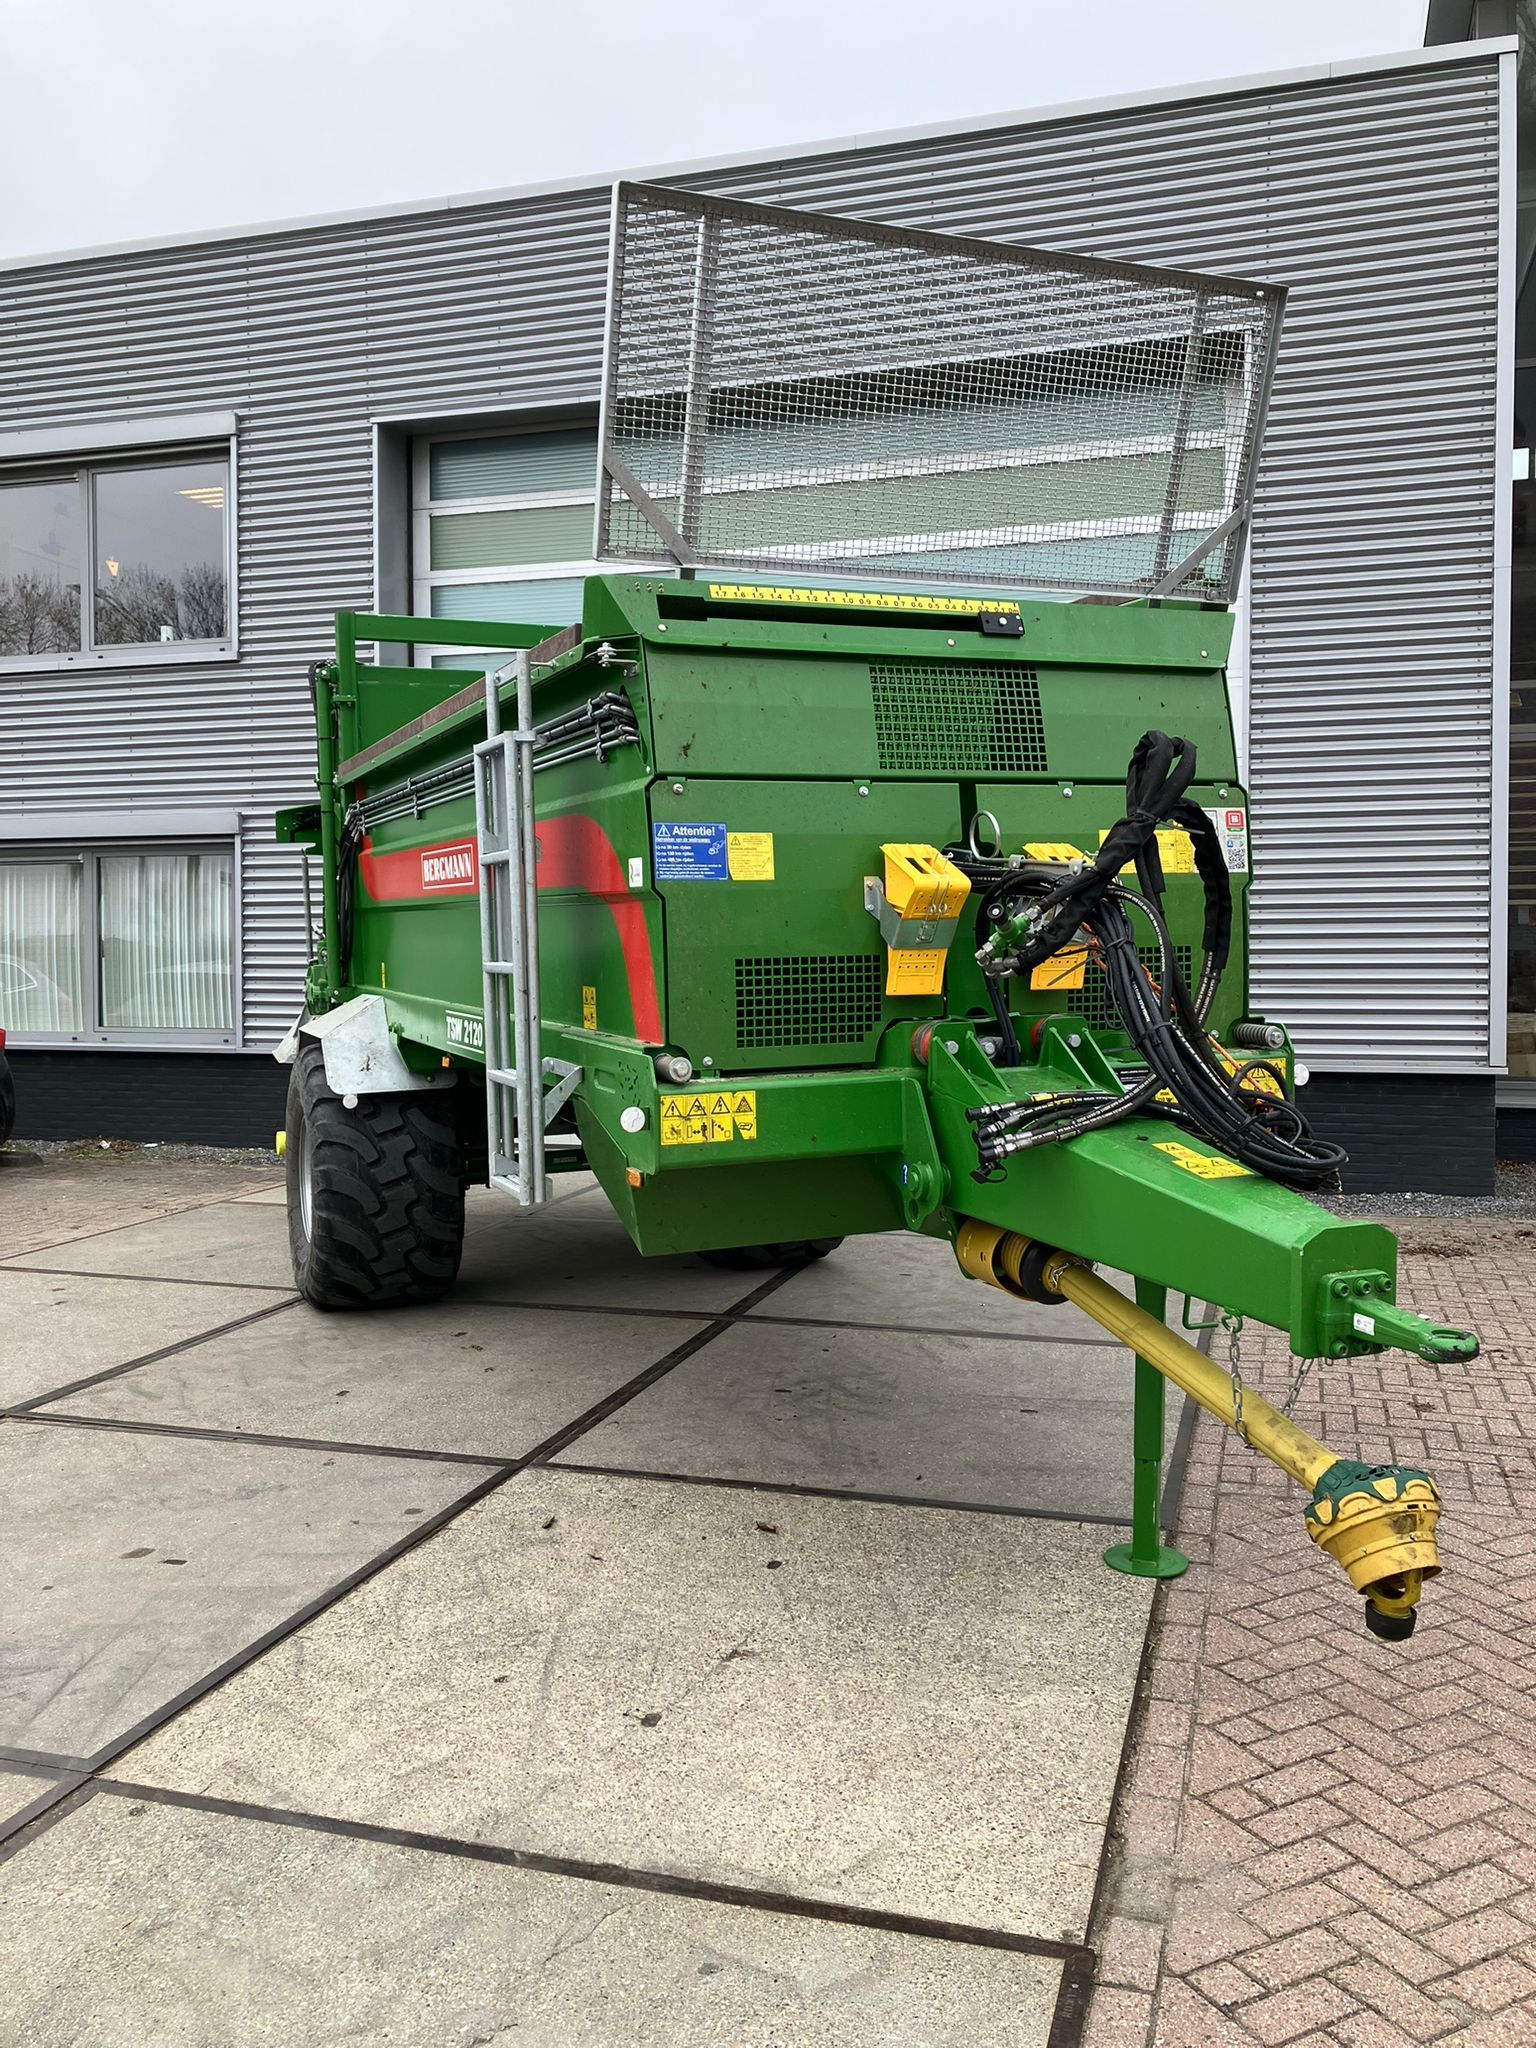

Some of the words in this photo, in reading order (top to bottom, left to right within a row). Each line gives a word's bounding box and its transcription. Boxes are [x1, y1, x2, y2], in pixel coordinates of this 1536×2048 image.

[672, 825, 715, 837] Attentie!
[423, 852, 472, 882] BERGMANN
[446, 1016, 463, 1042] TSW
[463, 1020, 484, 1047] 2120
